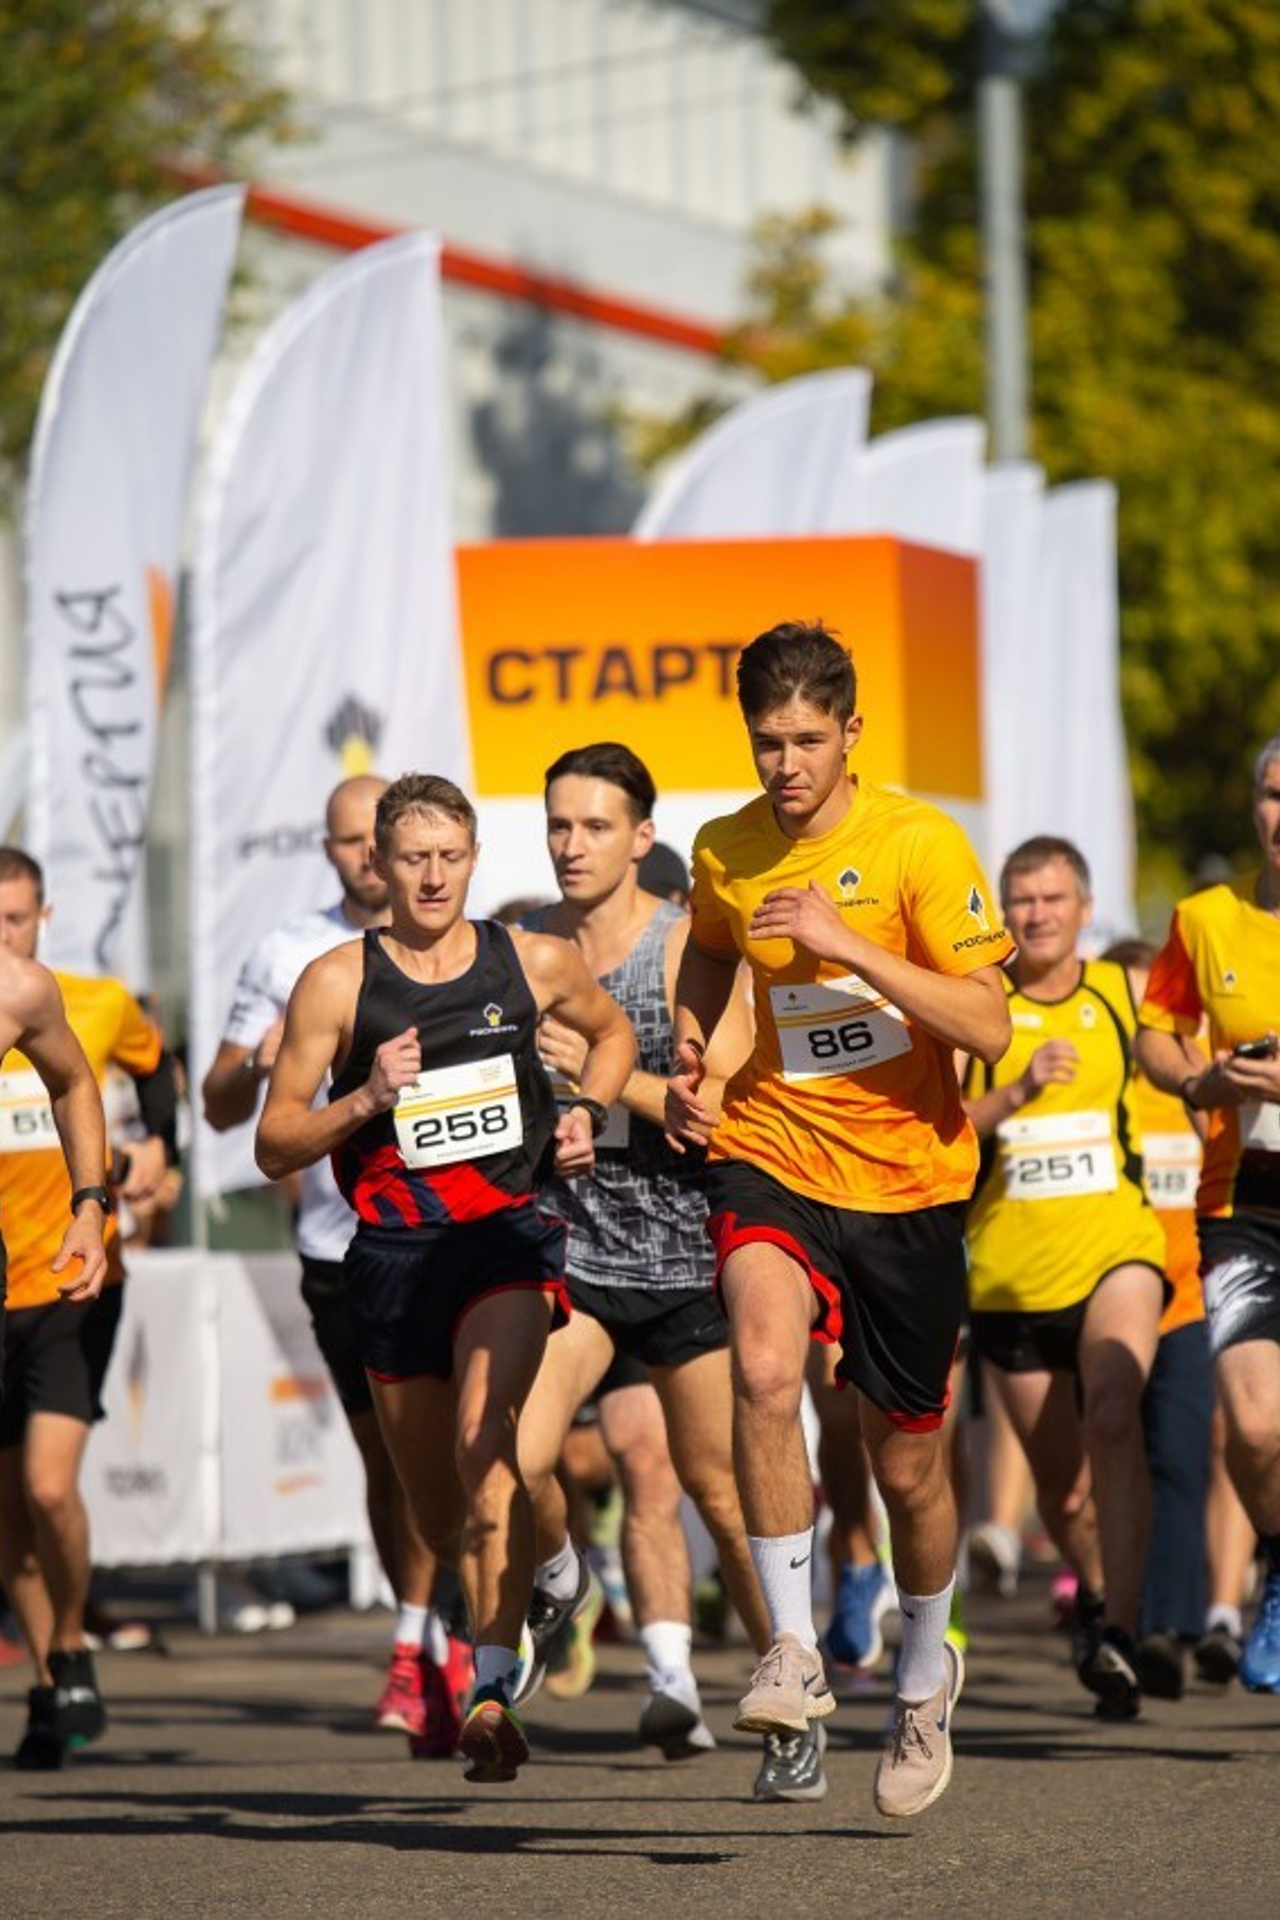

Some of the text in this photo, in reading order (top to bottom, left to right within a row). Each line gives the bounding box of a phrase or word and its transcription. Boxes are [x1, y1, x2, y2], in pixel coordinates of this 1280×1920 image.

[487, 642, 743, 706] СТАРТ
[808, 1021, 874, 1058] 86
[412, 1104, 509, 1149] 258
[1018, 1153, 1095, 1184] 251
